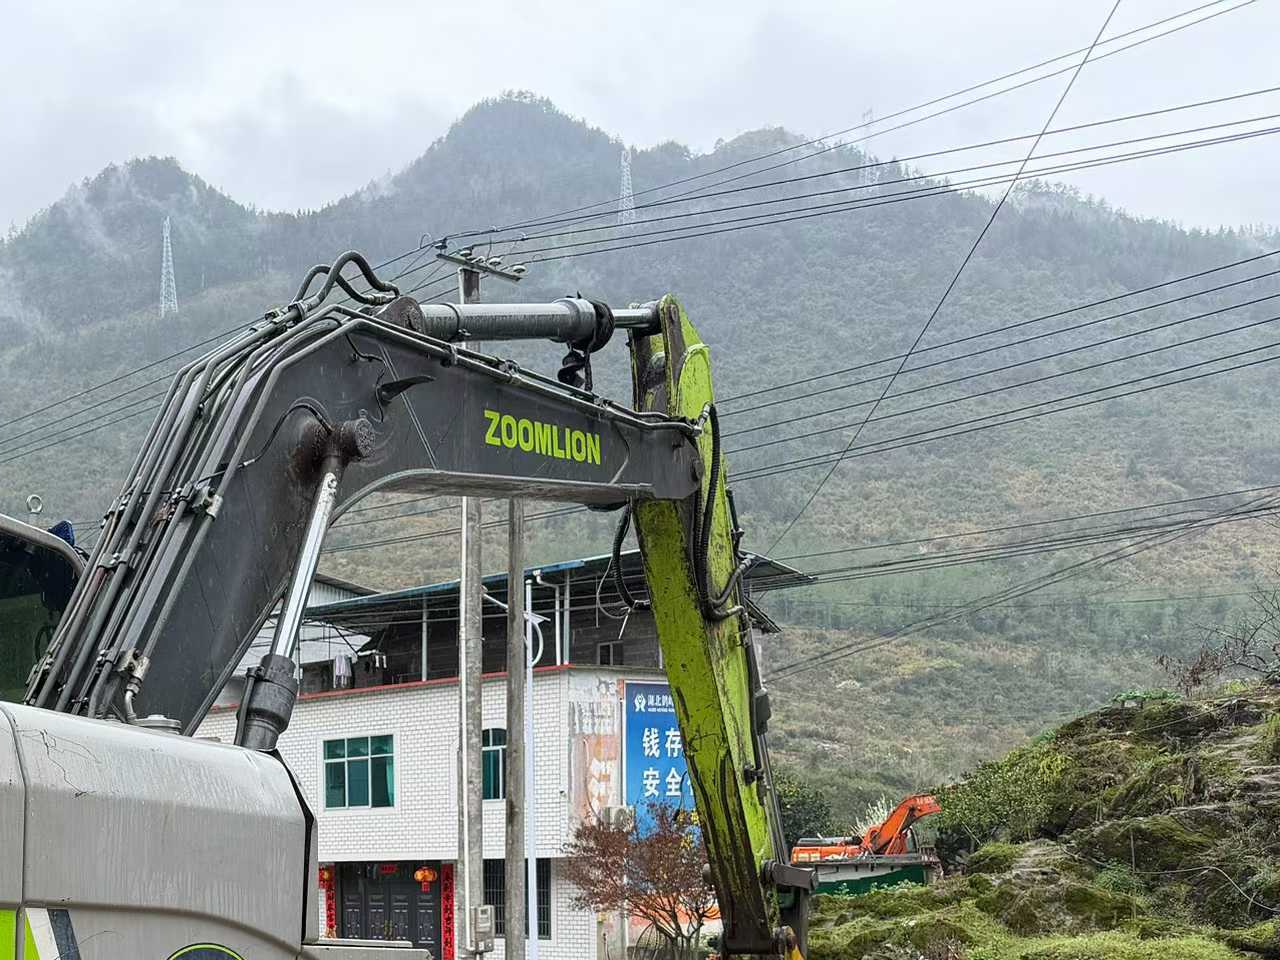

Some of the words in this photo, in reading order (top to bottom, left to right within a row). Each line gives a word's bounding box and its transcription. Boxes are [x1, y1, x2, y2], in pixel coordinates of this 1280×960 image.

[484, 409, 601, 465] ZOOMLION
[642, 727, 682, 758] 钱存
[642, 767, 694, 798] 安全
